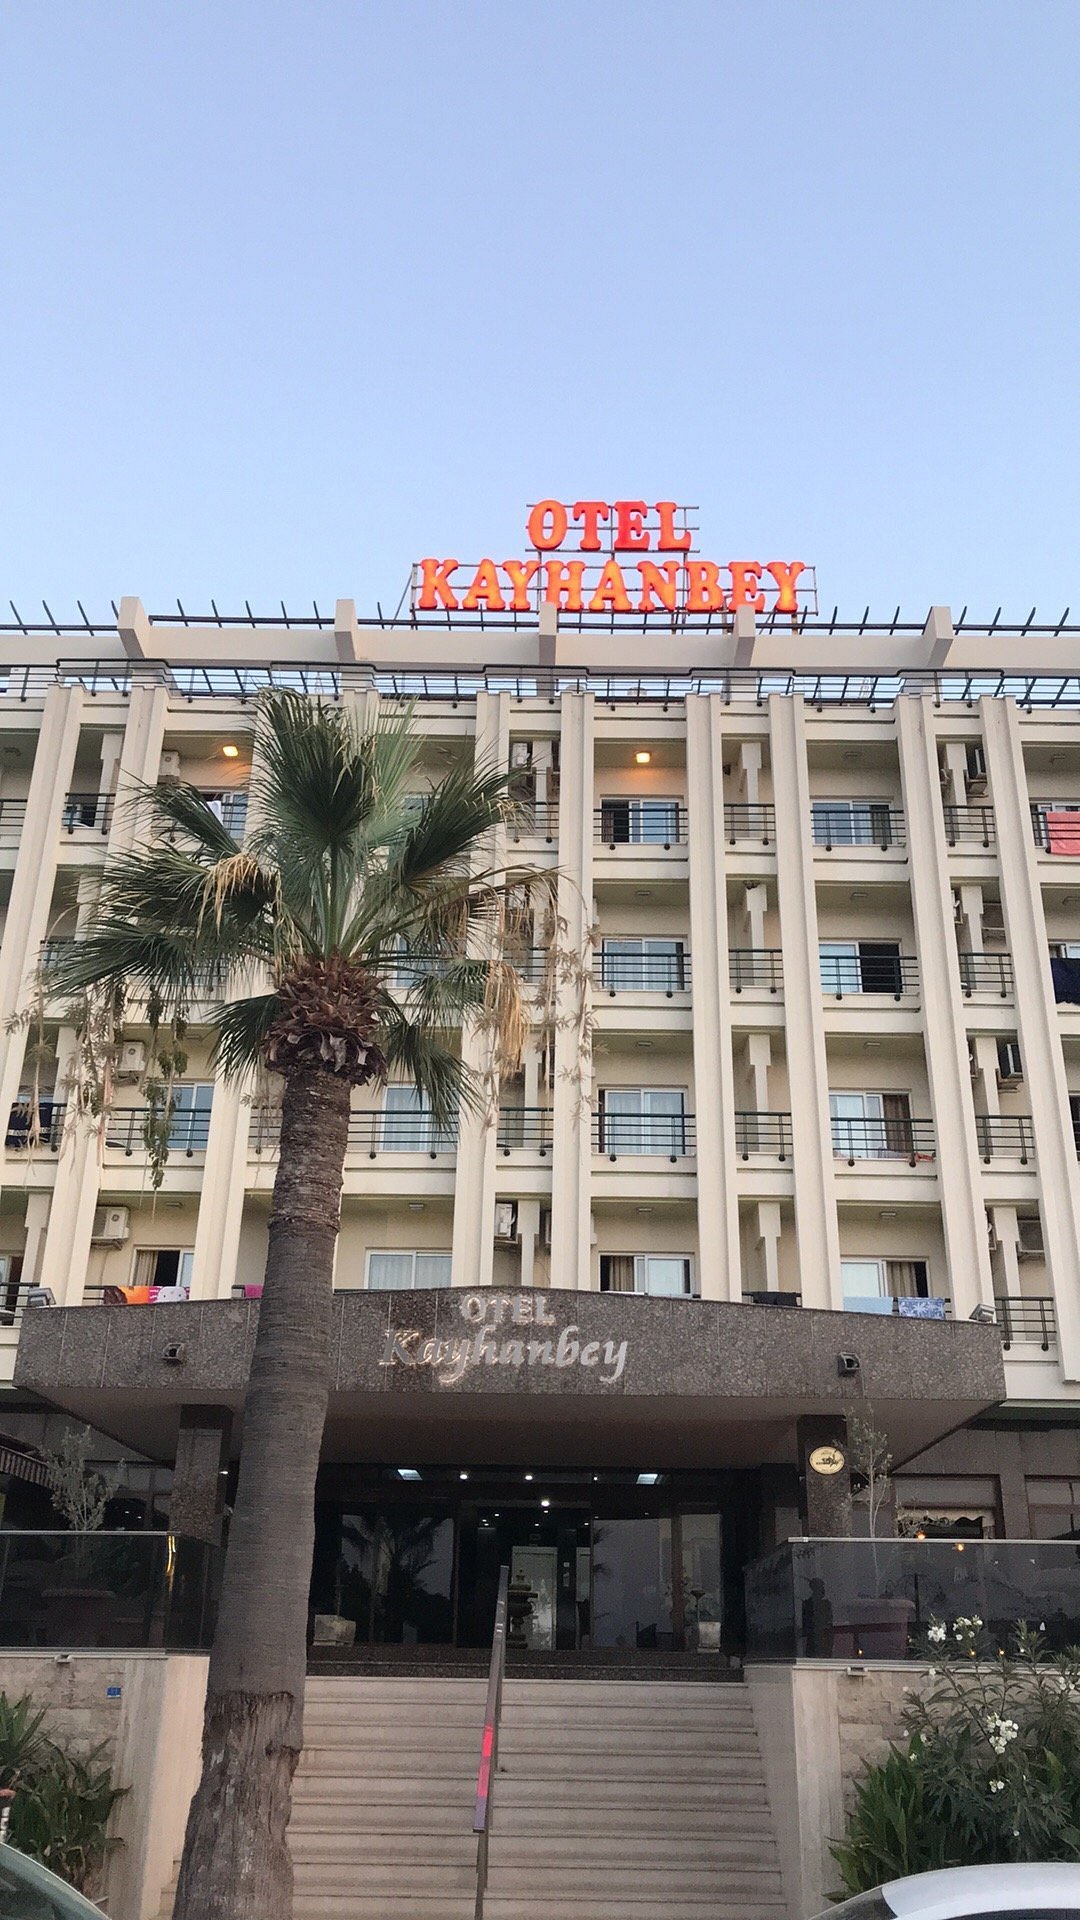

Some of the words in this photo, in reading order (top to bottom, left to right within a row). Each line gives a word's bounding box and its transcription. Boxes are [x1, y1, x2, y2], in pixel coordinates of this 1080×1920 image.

[528, 499, 691, 551] OTEL
[418, 558, 805, 612] KAYHANBEY
[460, 1293, 556, 1325] OTEL
[379, 1324, 629, 1384] Kayhanbey
